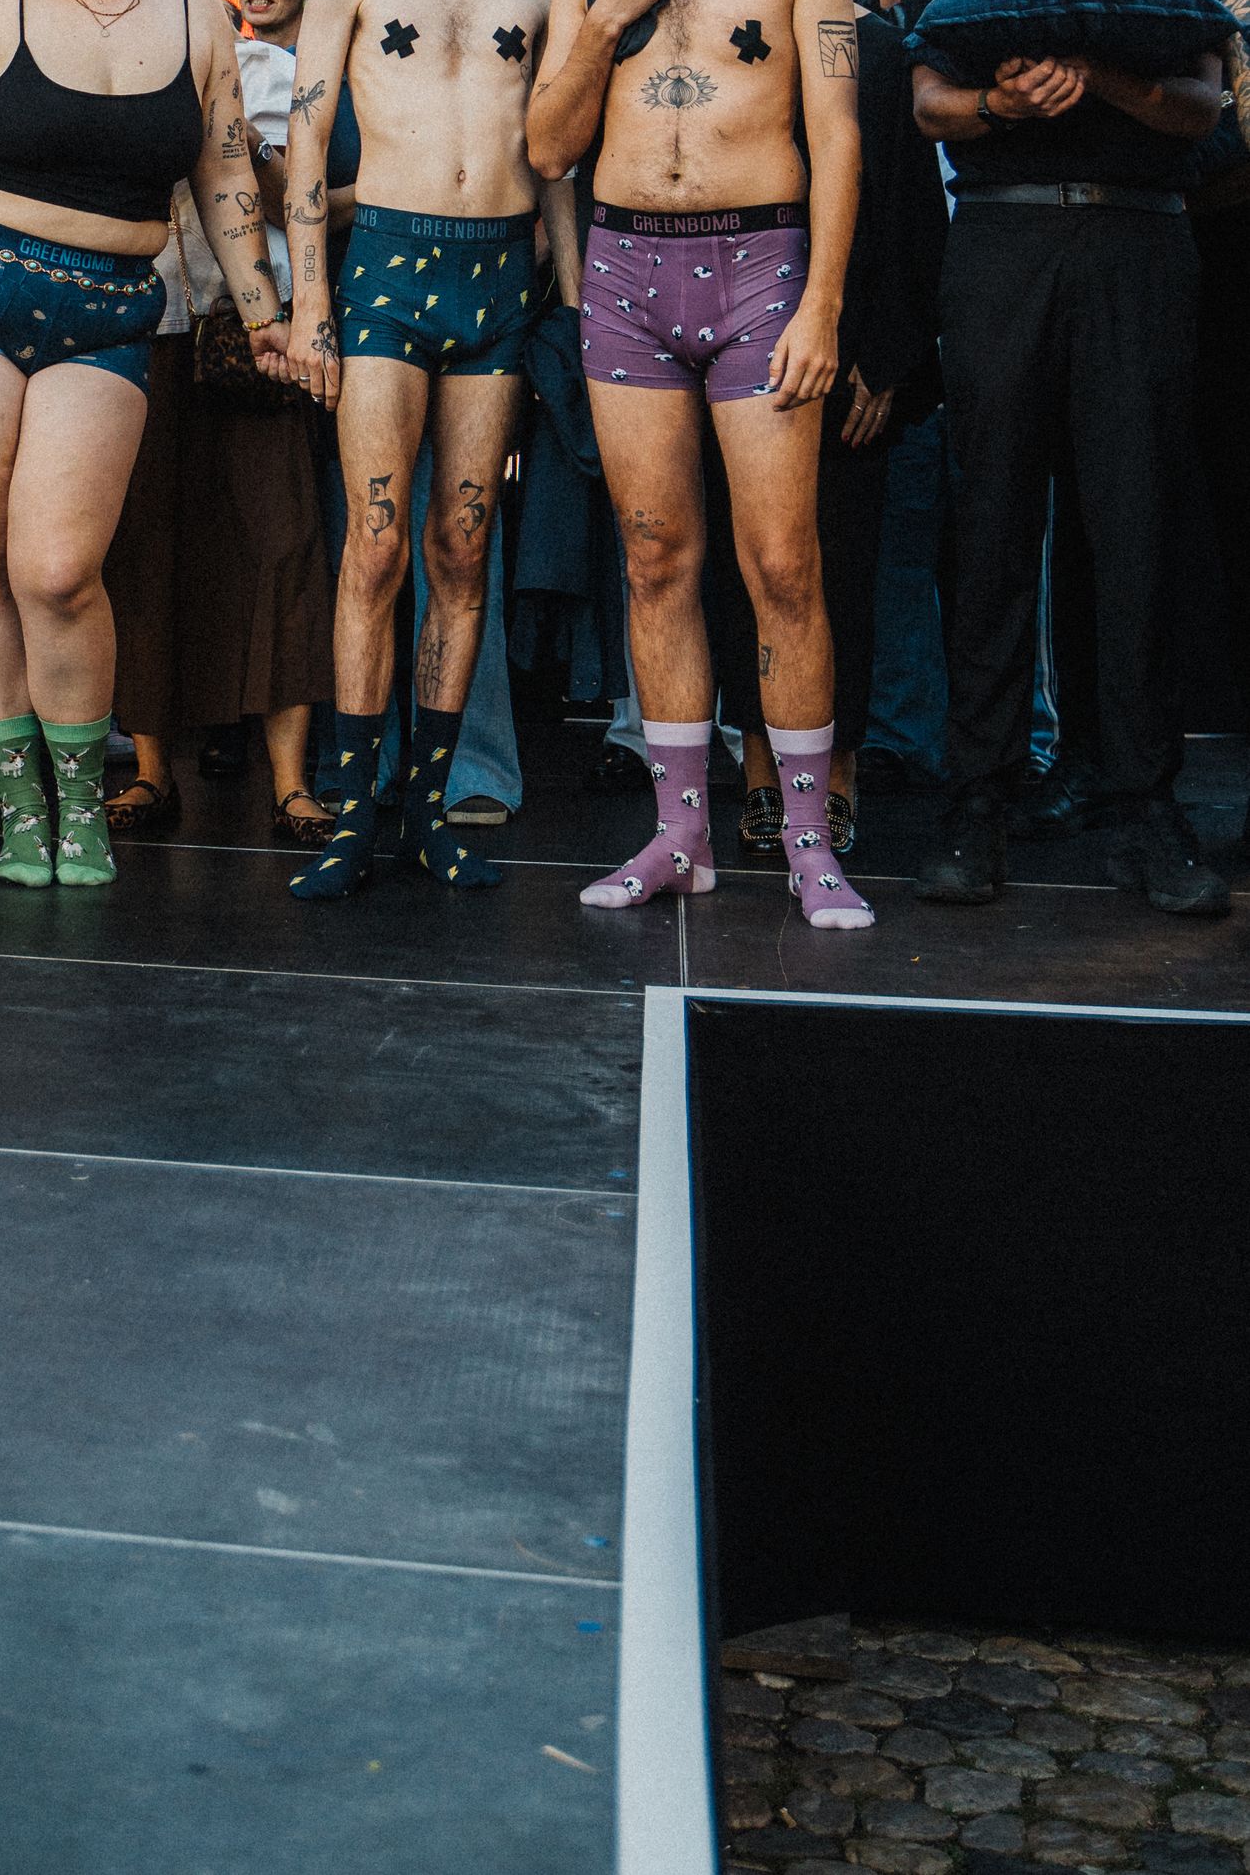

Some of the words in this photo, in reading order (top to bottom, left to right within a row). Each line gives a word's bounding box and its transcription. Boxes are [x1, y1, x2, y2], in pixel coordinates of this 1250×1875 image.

[411, 216, 508, 239] GREENBOMB
[633, 213, 741, 233] GREENBOMB
[19, 238, 115, 272] GREENBOMB
